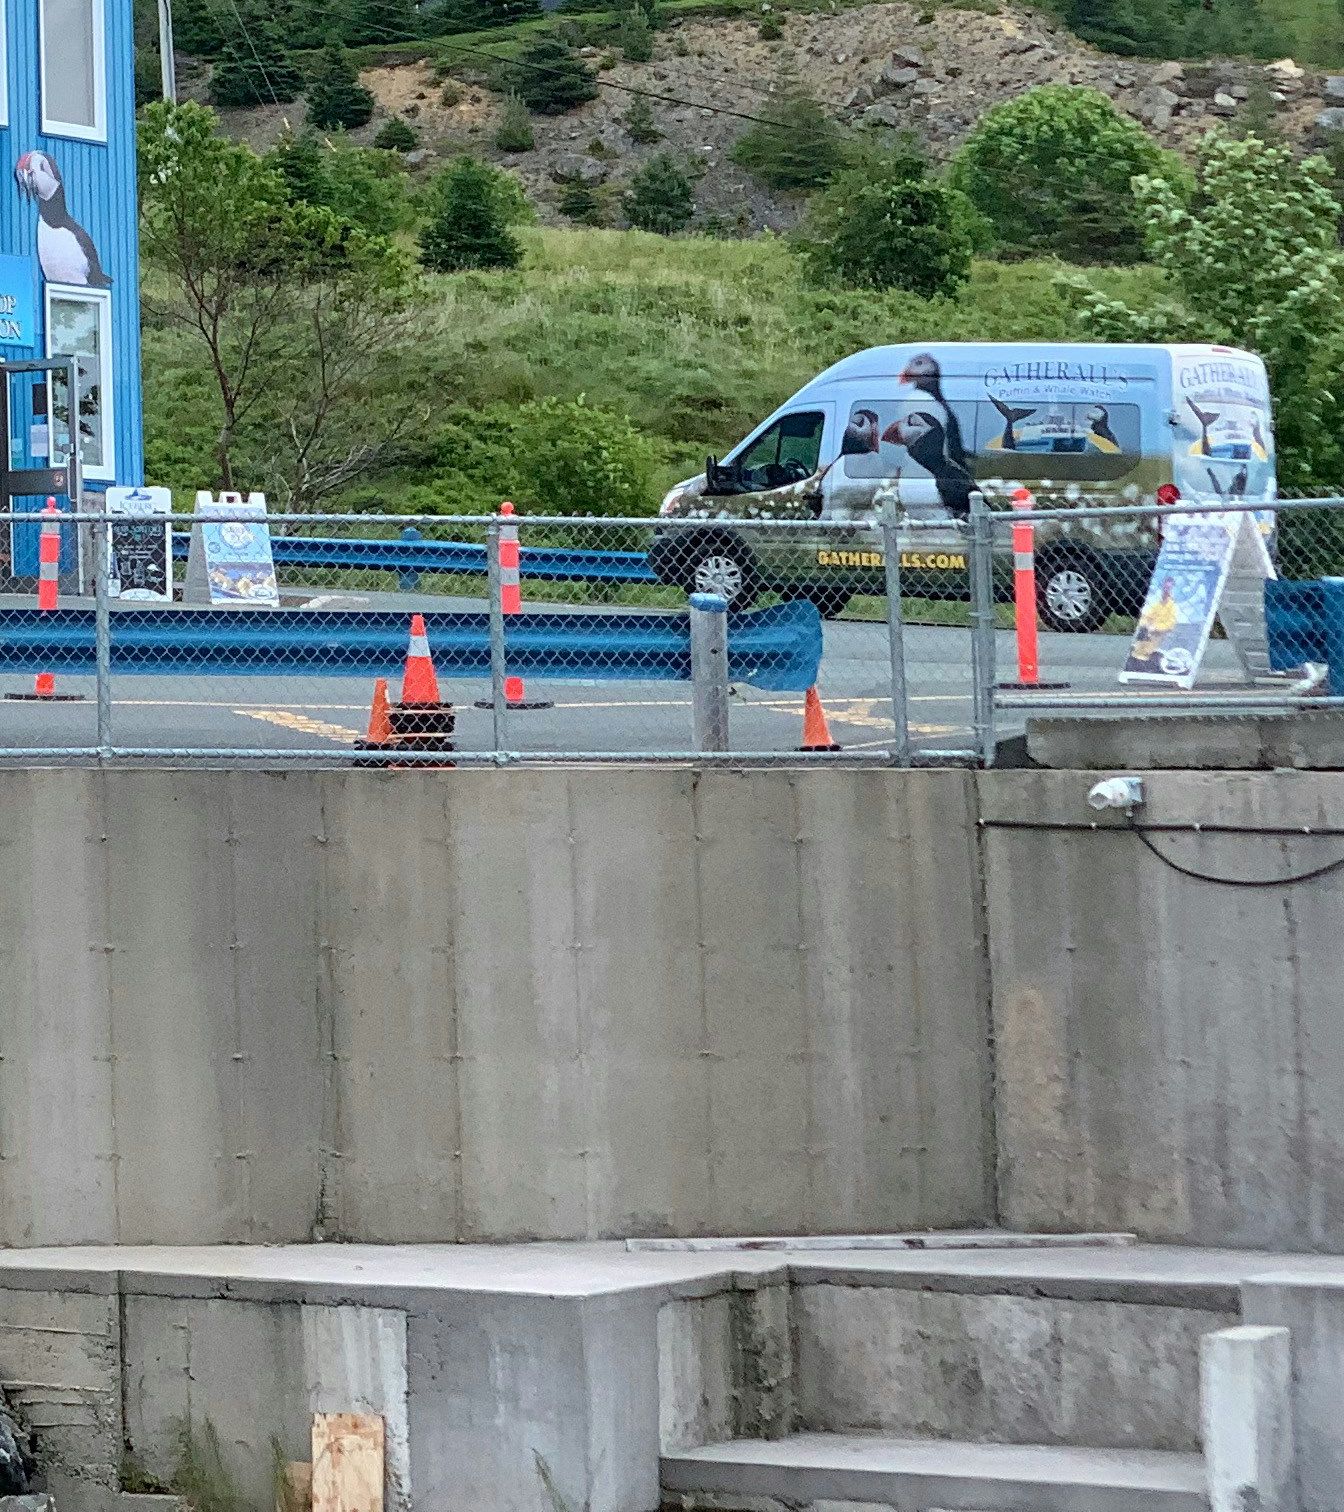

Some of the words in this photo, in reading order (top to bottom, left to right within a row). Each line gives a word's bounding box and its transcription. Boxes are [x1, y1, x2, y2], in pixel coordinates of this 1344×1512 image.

[984, 360, 1129, 392] GATHERALL'S
[1180, 362, 1265, 392] GATHERALL
[998, 387, 1031, 399] Puffin
[1044, 384, 1076, 395] Whale
[1079, 387, 1112, 400] Watch
[817, 551, 966, 569] GATHERLS.COM
